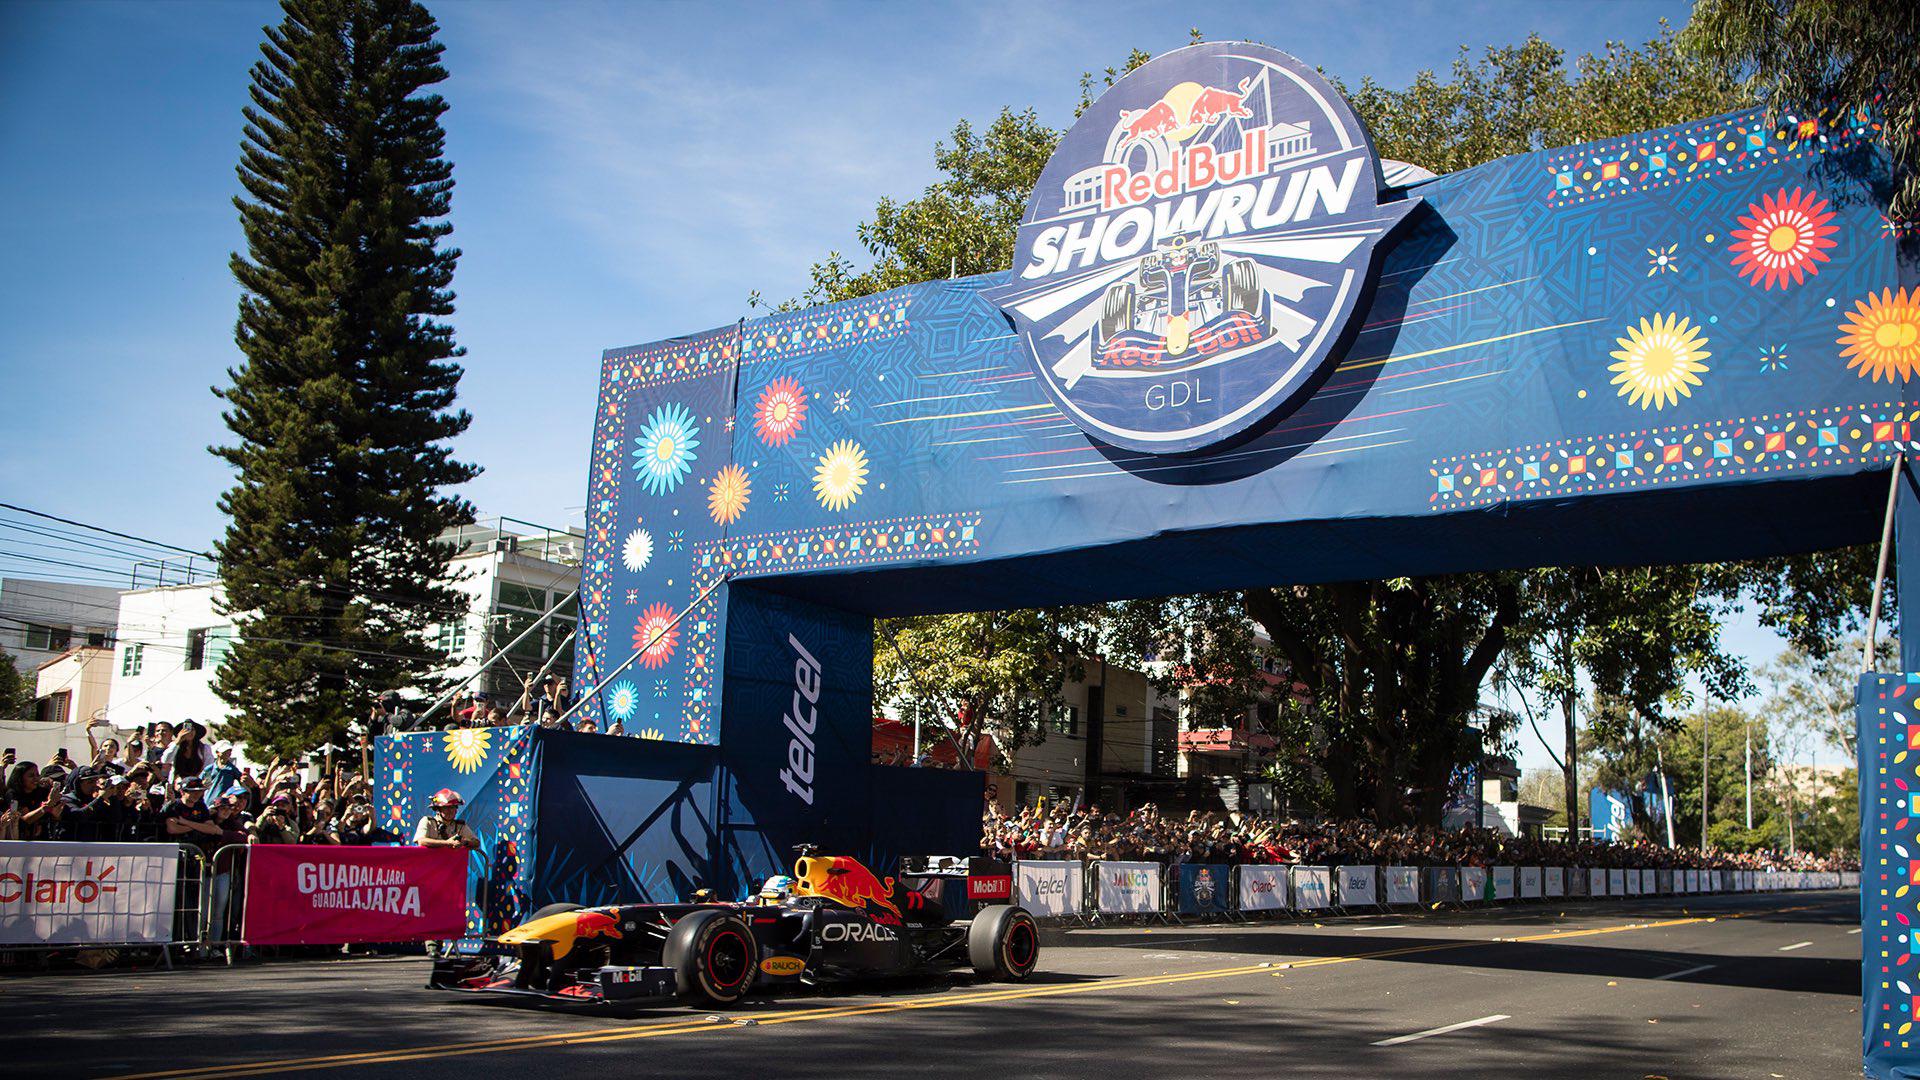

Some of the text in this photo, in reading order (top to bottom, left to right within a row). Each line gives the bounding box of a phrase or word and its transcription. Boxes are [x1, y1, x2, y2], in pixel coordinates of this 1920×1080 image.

[1104, 129, 1267, 209] Red Bull
[1020, 156, 1366, 280] SHOWRUN
[1145, 377, 1212, 411] GDL
[779, 632, 822, 806] telcel
[1607, 794, 1626, 847] elcel
[0, 872, 98, 904] Claro
[297, 862, 406, 894] GUADALAJARA
[973, 880, 998, 894] Mobil
[1035, 875, 1068, 896] telcel
[1251, 880, 1273, 893] Claro
[312, 886, 422, 918] GUADALAJARA
[611, 970, 643, 984] Mobil
[771, 961, 801, 971] RAUCH
